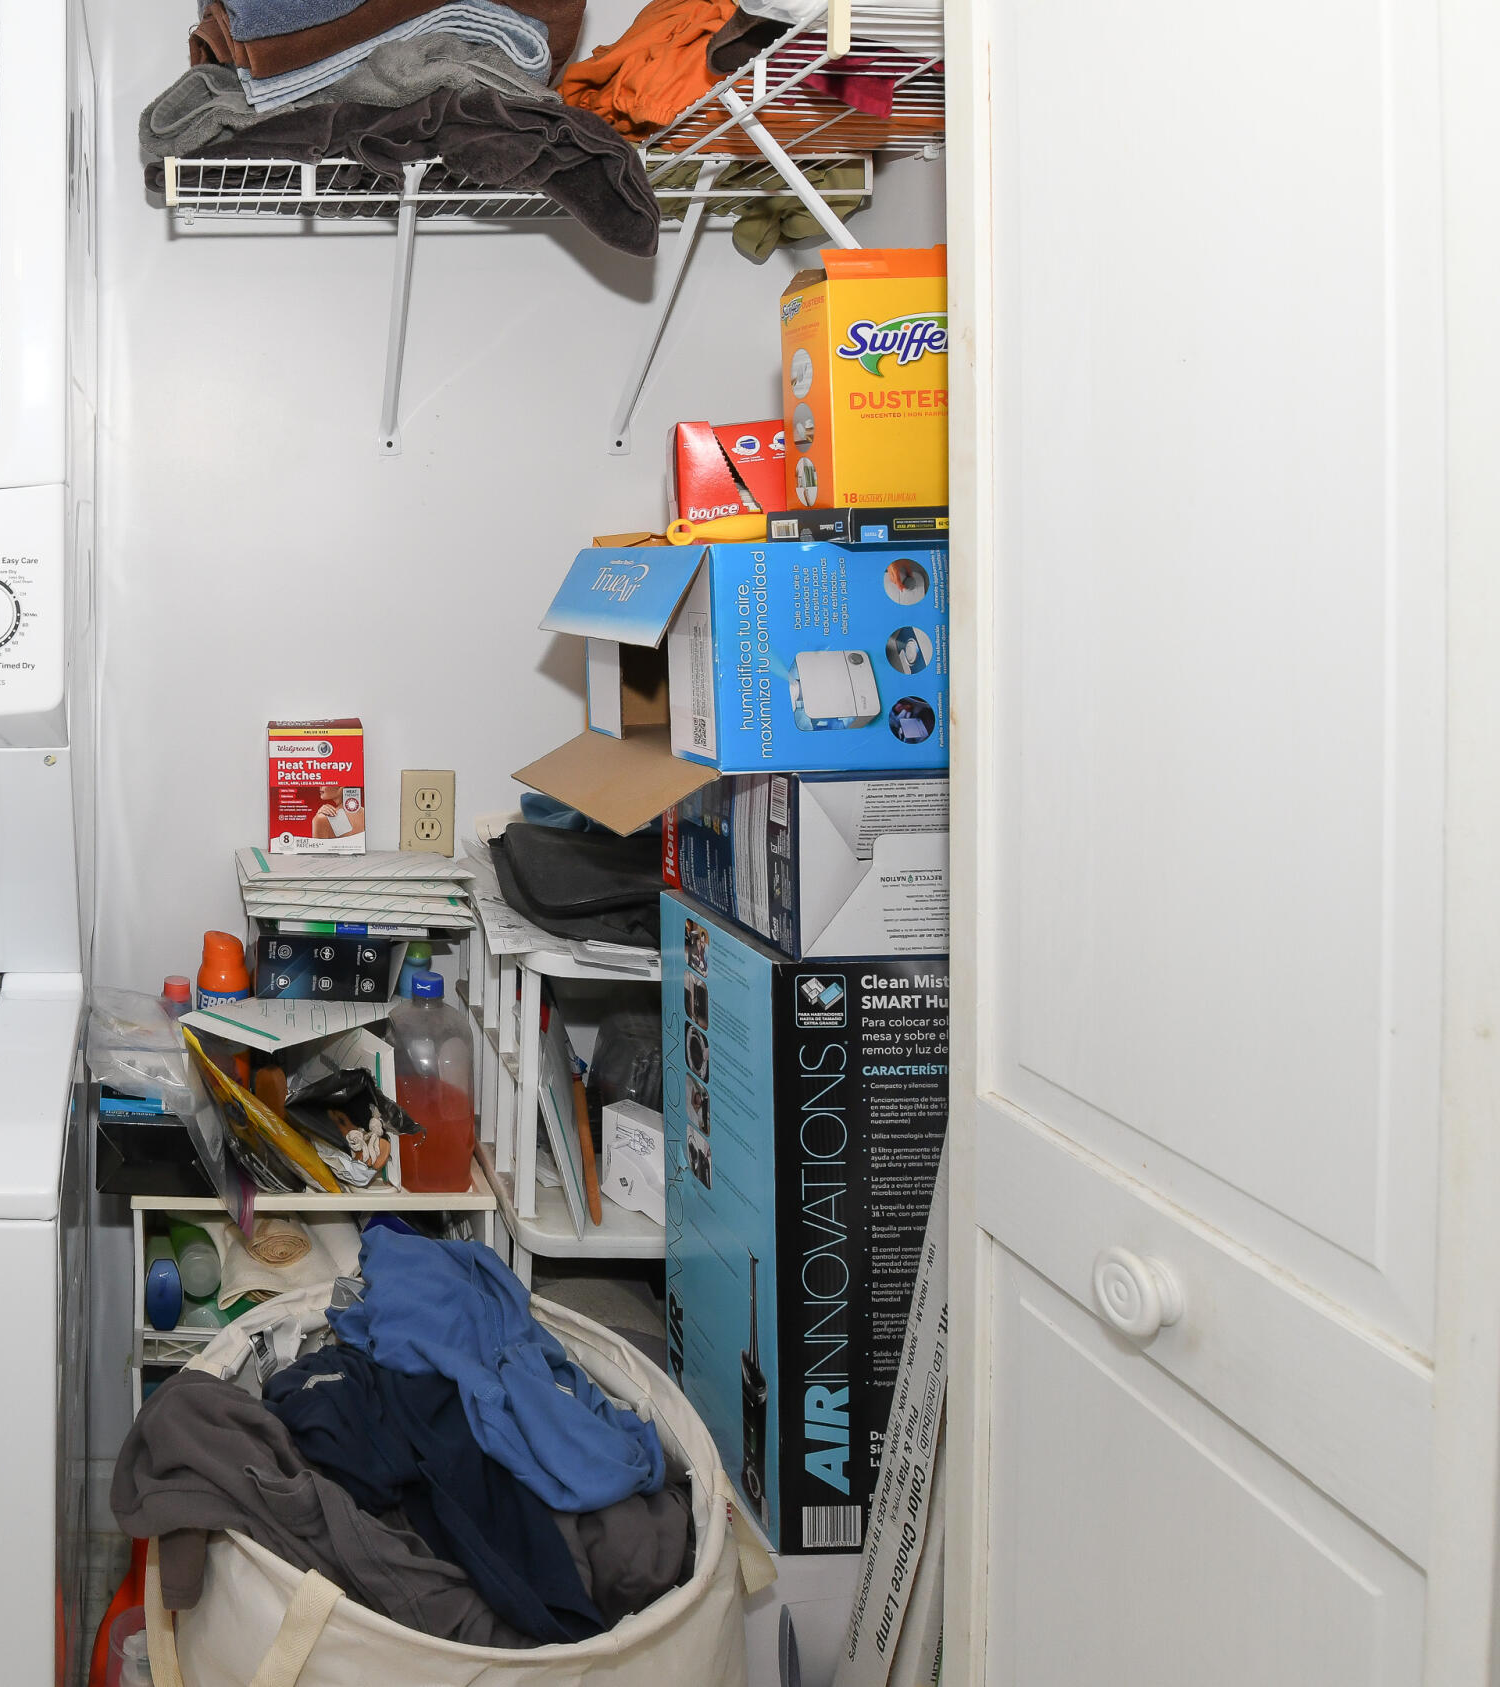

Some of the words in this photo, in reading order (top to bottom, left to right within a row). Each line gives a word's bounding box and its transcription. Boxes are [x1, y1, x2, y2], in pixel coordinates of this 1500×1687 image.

[688, 504, 739, 519] bounce
[844, 493, 857, 503] 18
[1, 557, 19, 565] Easy
[735, 579, 750, 616] aire,
[750, 551, 769, 653] comodidad
[803, 589, 811, 627] humedad
[737, 620, 751, 636] tu
[756, 657, 770, 674] tu
[737, 641, 754, 730] humidifica
[756, 679, 773, 759] maximiza
[277, 745, 315, 753] Walgreens
[277, 760, 304, 770] Heat
[306, 760, 352, 771] Therapy
[277, 771, 321, 780] Patches
[283, 835, 289, 843] 8
[880, 875, 907, 883] NATION
[860, 974, 909, 989] Clean
[861, 995, 922, 1010] SMART
[862, 1017, 885, 1027] Para
[889, 1016, 930, 1027] colocar
[862, 1032, 892, 1041] mesa
[895, 1033, 901, 1043] y
[904, 1030, 935, 1041] sobre
[862, 1045, 903, 1055] remoto
[906, 1046, 912, 1057] y
[915, 1044, 931, 1055] luz
[927, 1243, 937, 1268] 18W
[916, 1279, 929, 1322] 1800LM
[909, 1332, 919, 1370] 3000K
[933, 1340, 945, 1373] LED
[898, 1377, 910, 1414] 4100K
[905, 1404, 919, 1438] Plug
[889, 1421, 902, 1458] 5000K
[903, 1443, 913, 1454] &
[896, 1455, 911, 1491] Play
[876, 1467, 893, 1527] REPLACES
[907, 1464, 926, 1521] Color
[873, 1529, 882, 1543] T8
[891, 1522, 917, 1593] Choice
[857, 1543, 879, 1623] FLUORESCENT
[876, 1593, 900, 1653] Lamp
[848, 1620, 861, 1662] LAMPS
